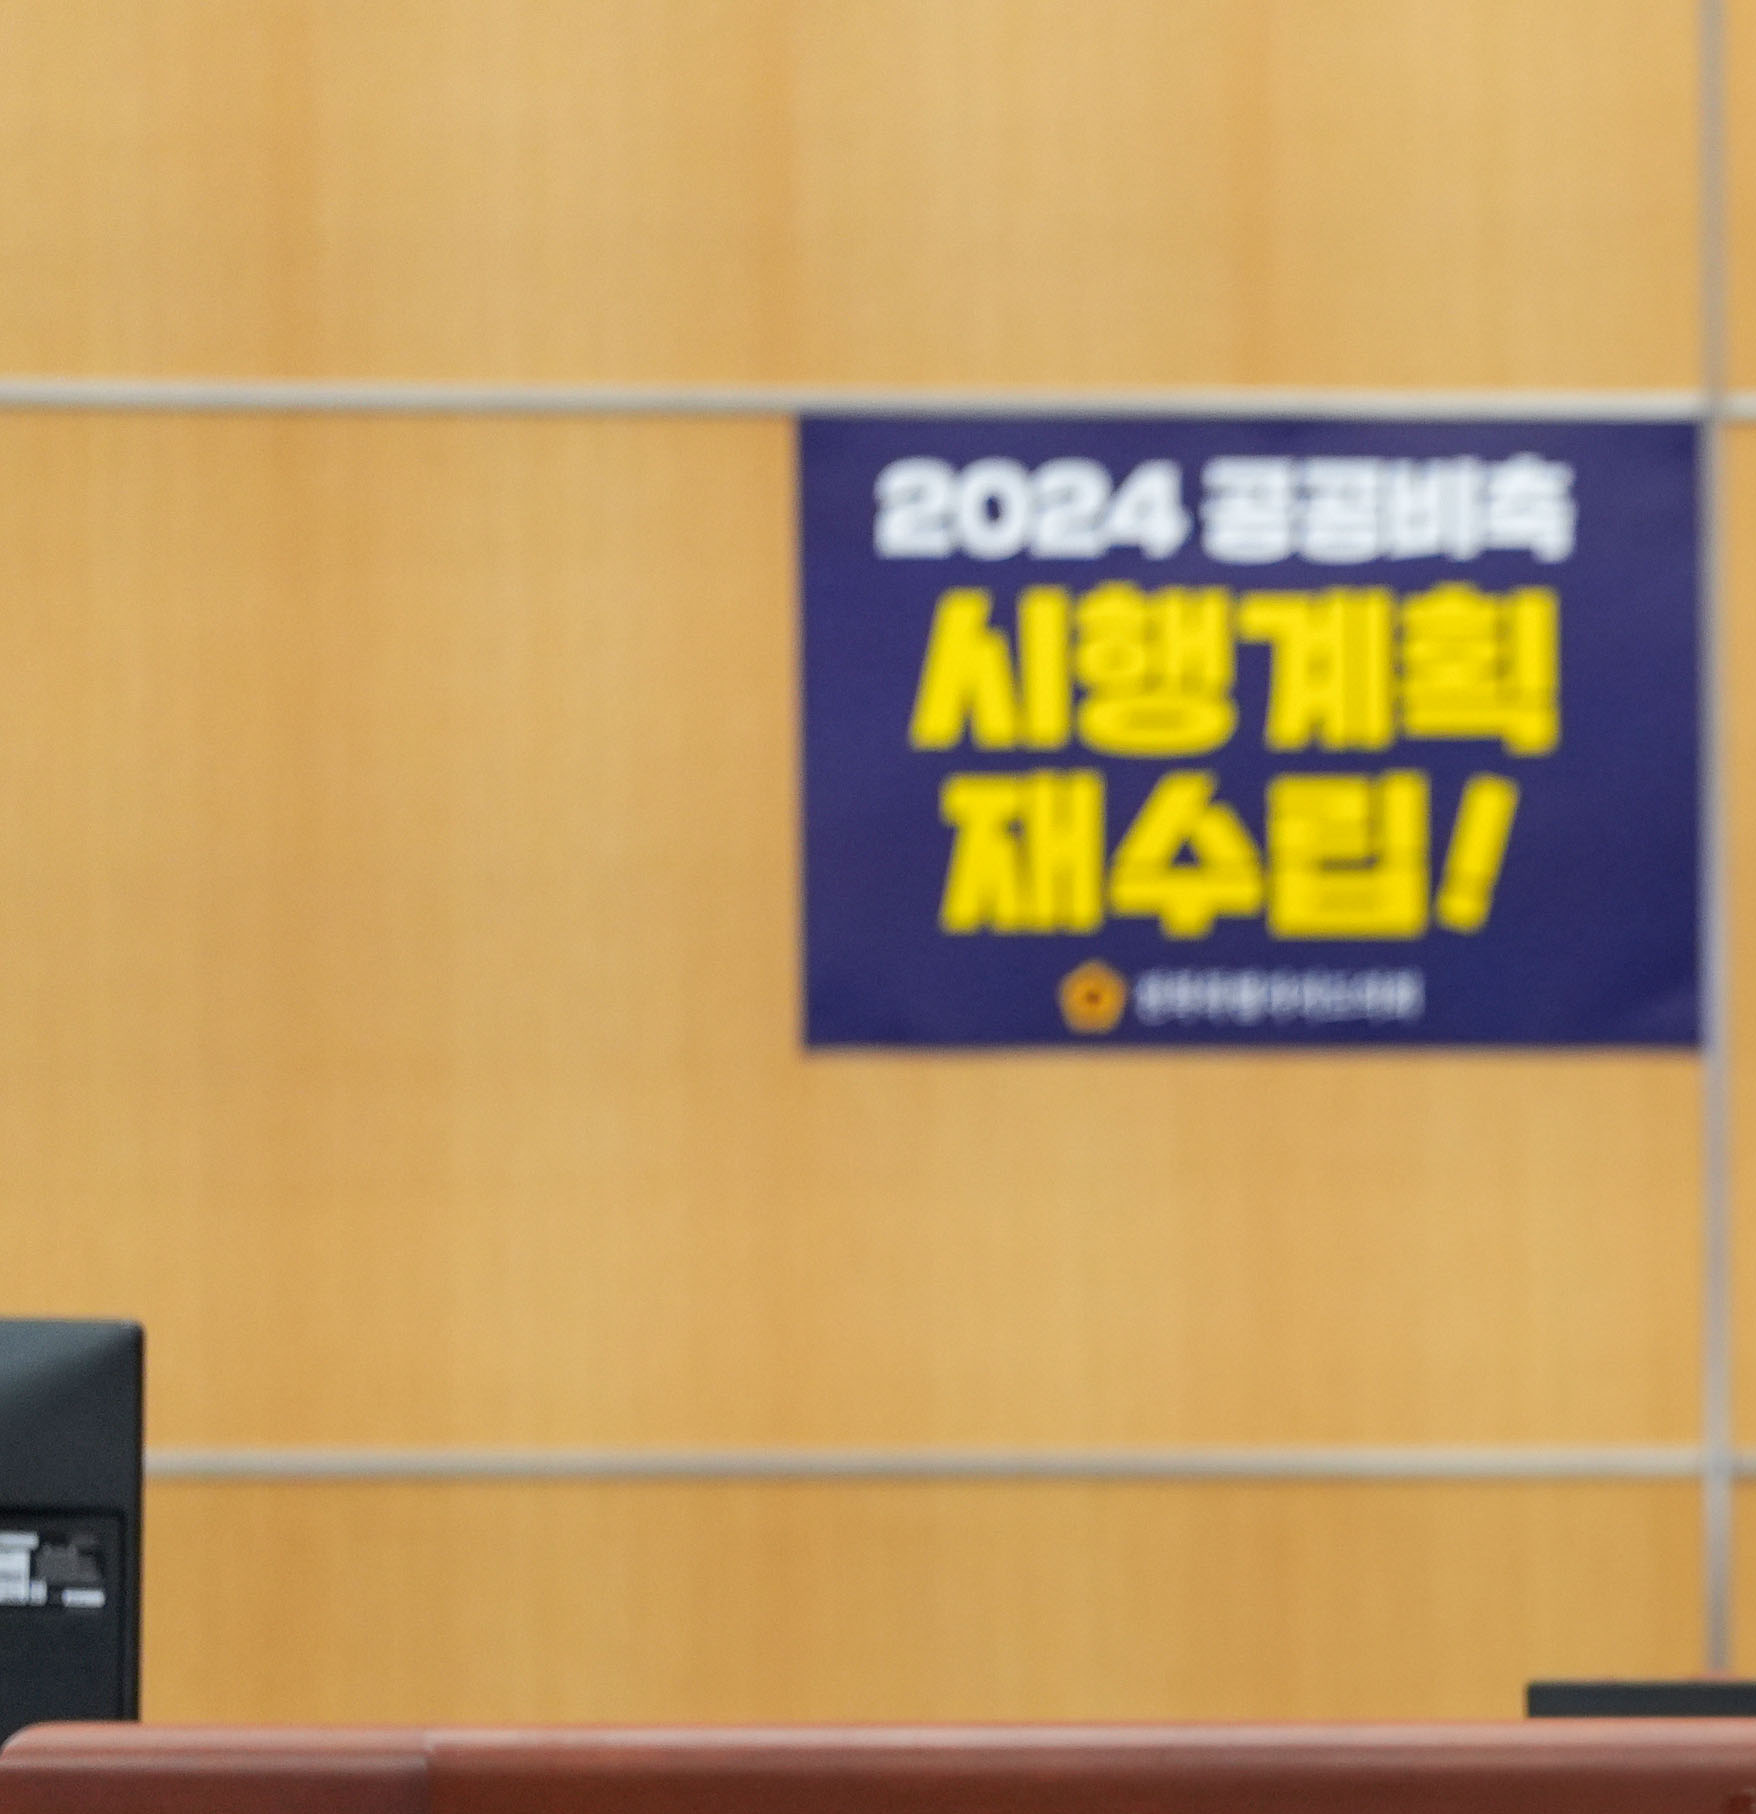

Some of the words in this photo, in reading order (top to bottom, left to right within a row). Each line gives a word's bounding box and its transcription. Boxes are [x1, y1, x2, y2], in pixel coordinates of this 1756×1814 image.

[876, 458, 1190, 559] 2024
[1203, 455, 1574, 563] 공공비축
[911, 581, 1559, 757] 시행계획
[941, 770, 1519, 938] 재수립!
